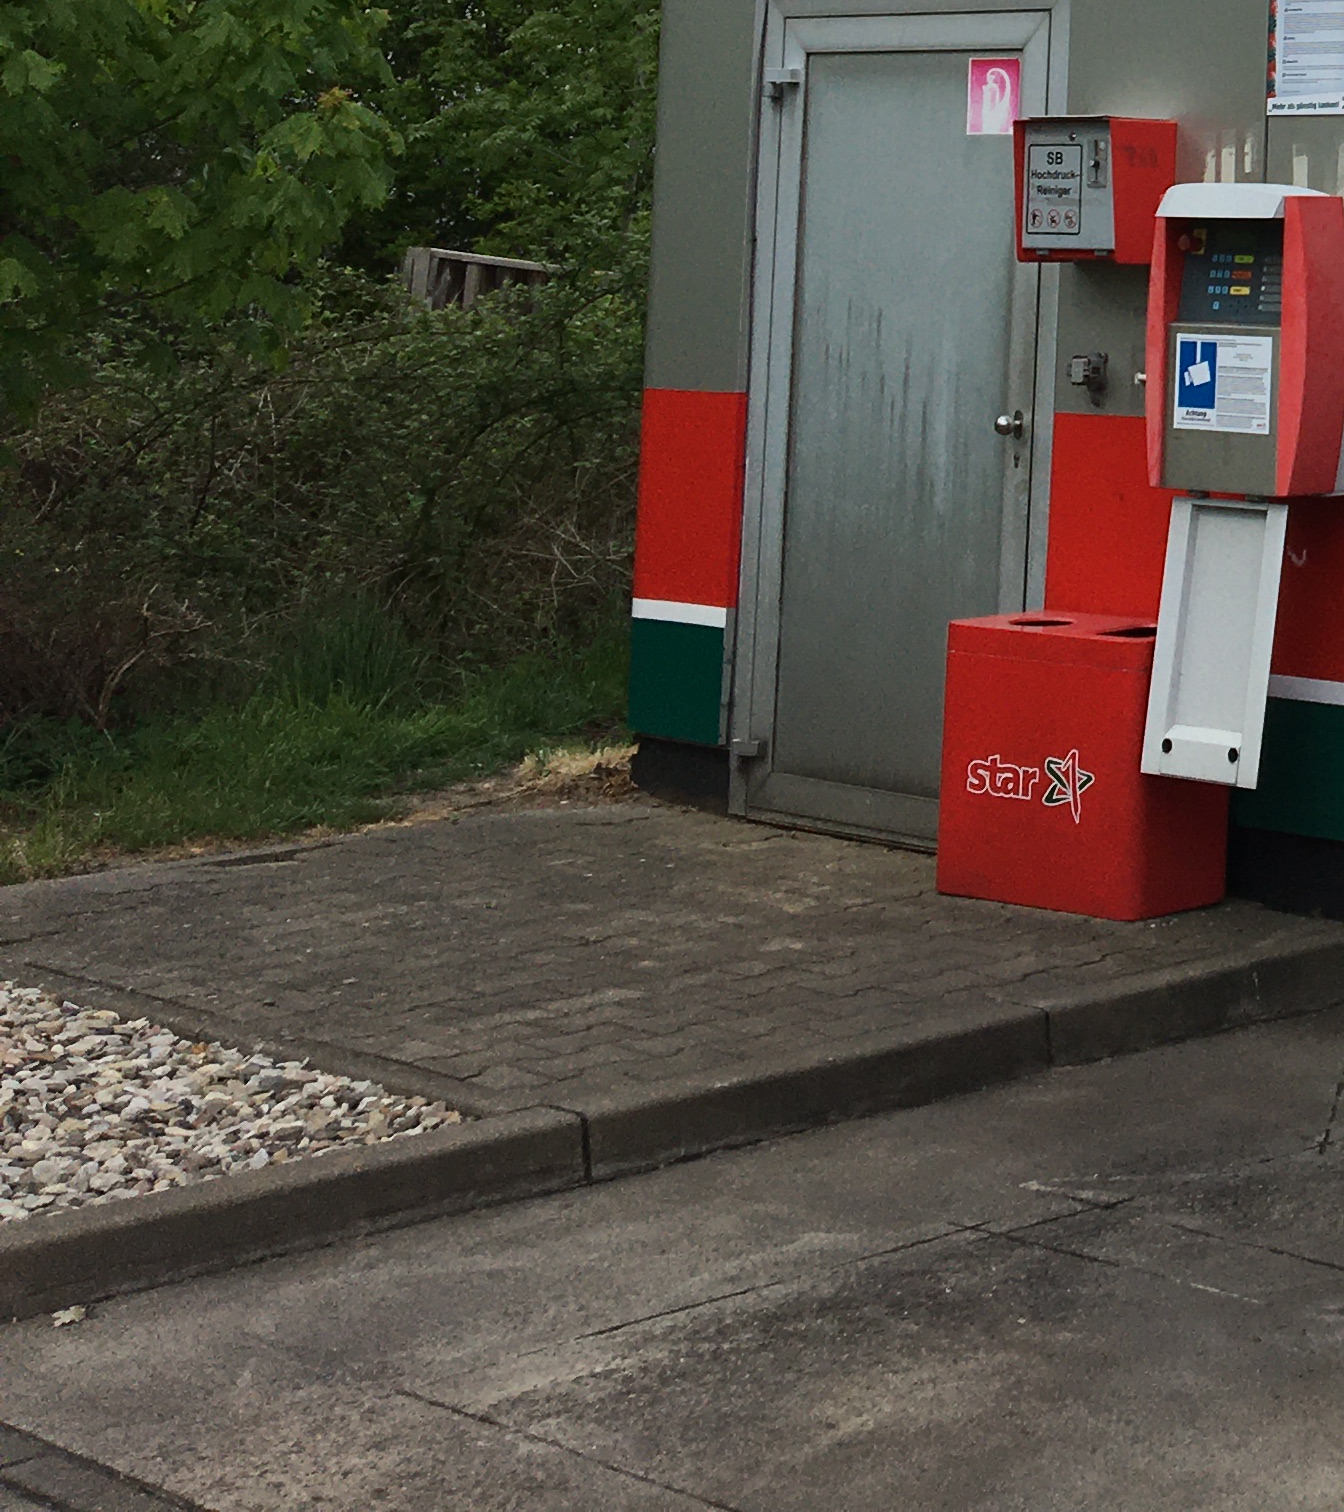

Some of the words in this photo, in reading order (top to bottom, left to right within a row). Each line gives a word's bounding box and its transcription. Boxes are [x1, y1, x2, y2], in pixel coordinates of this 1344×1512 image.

[1046, 151, 1064, 166] SB
[1031, 169, 1081, 180] Hochdruck-
[1036, 185, 1072, 198] Reiniger
[966, 754, 1040, 801] star
